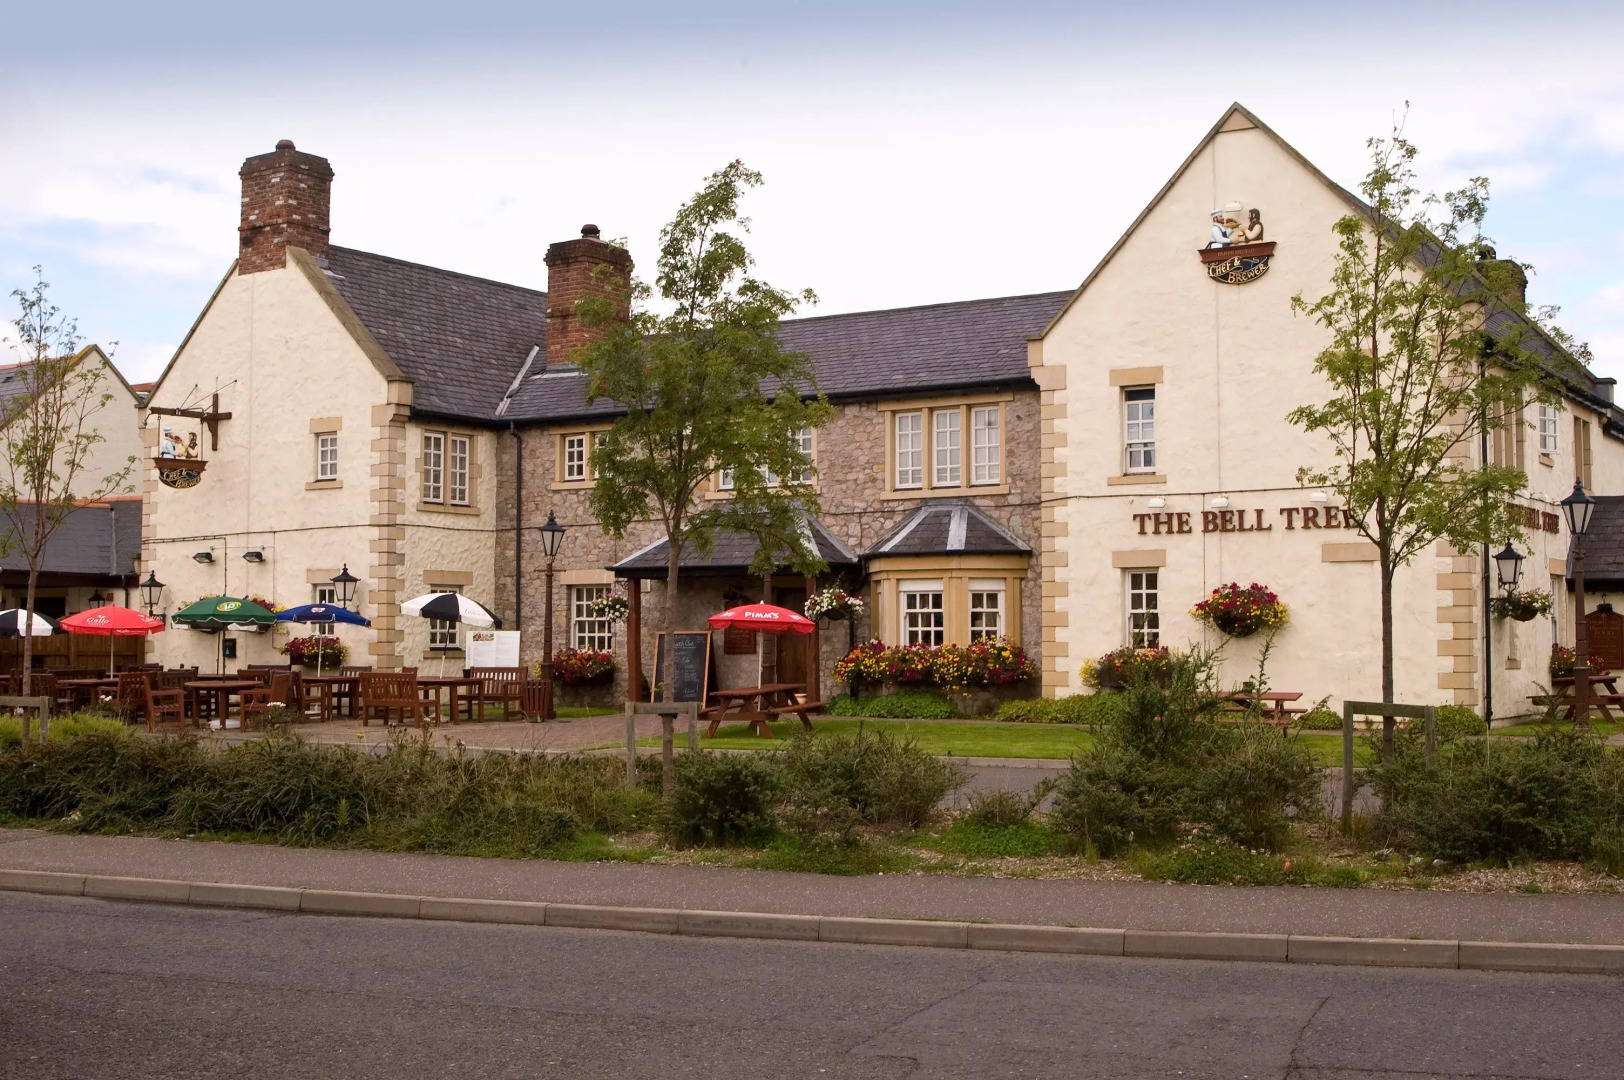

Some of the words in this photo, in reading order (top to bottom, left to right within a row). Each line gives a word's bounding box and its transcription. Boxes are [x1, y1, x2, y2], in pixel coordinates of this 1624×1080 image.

[1209, 262, 1231, 277] CHEF
[1233, 257, 1241, 266] &
[1228, 263, 1266, 283] BREWER
[1132, 512, 1192, 535] THE
[1201, 508, 1272, 533] BELL
[86, 617, 110, 625] Gallo
[744, 611, 779, 619] PIMM'S
